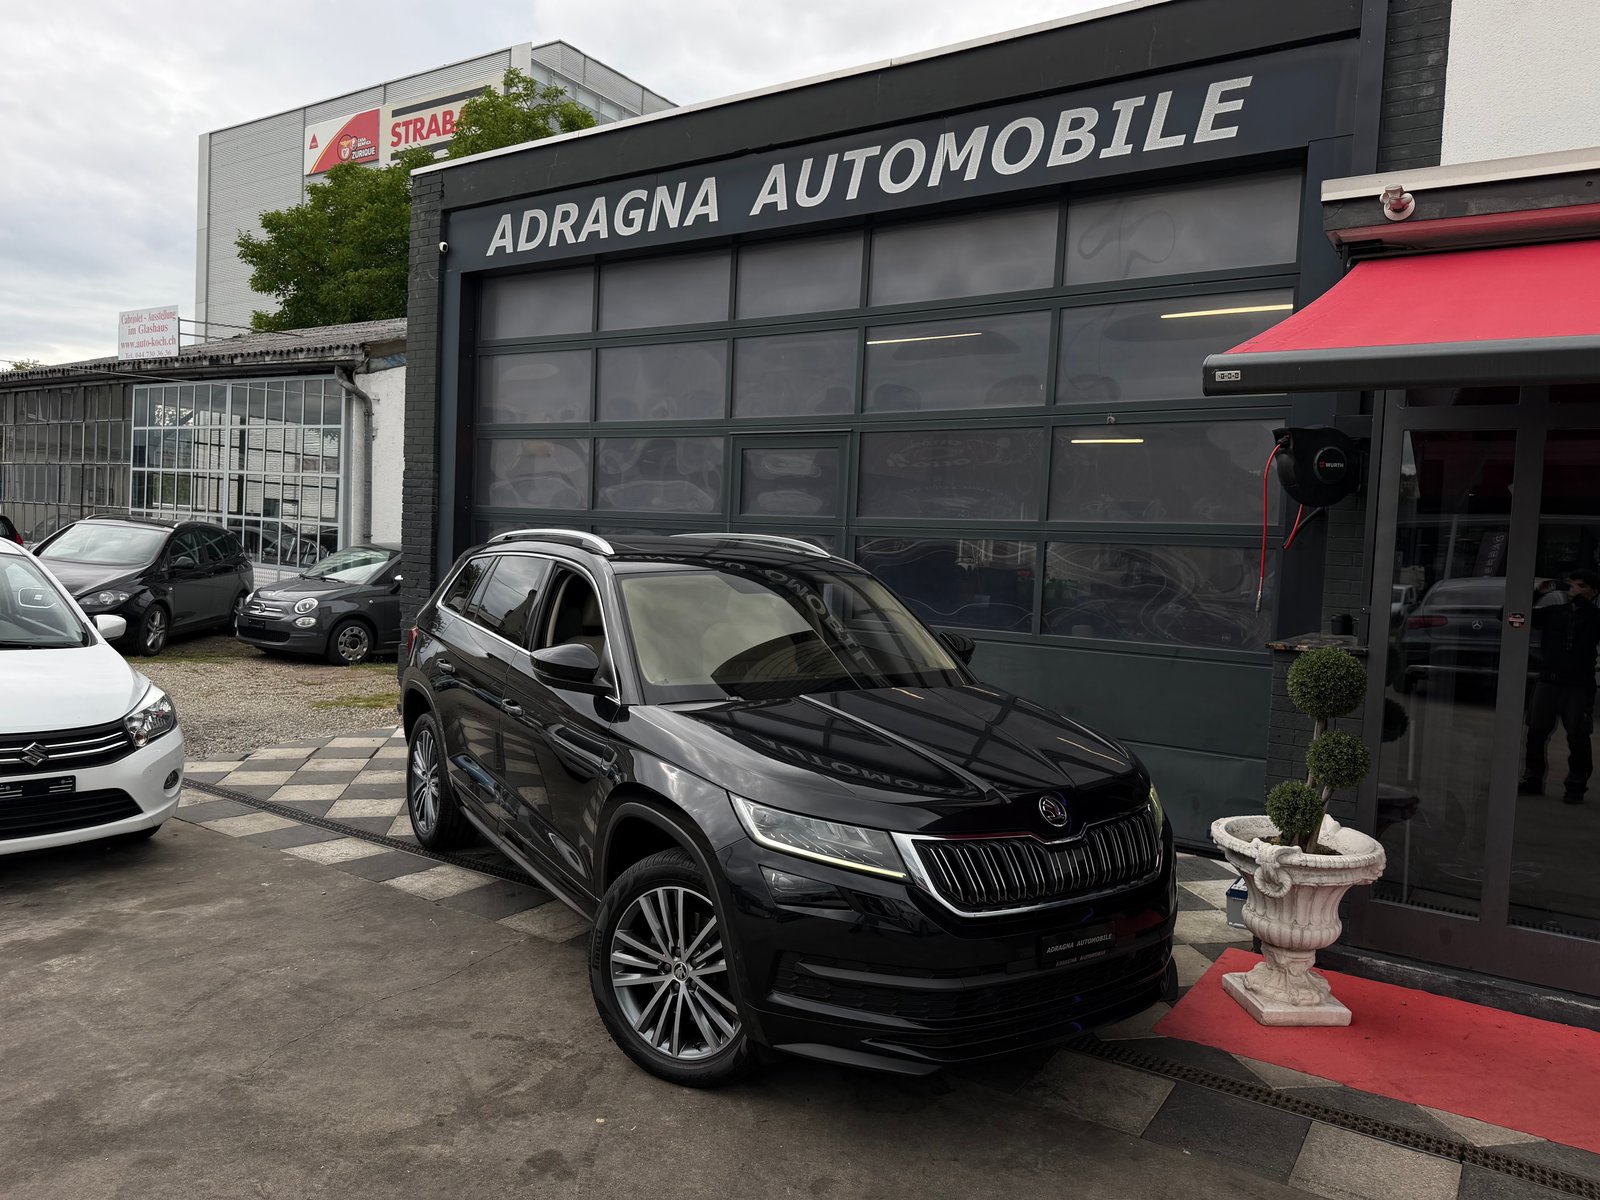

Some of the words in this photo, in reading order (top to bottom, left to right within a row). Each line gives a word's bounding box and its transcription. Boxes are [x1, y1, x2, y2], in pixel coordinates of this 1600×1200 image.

[351, 146, 376, 160] ZURIQUE
[485, 176, 720, 257] ADRAGNA
[749, 75, 1254, 216] AUTOMOBILE
[127, 326, 136, 335] im
[138, 322, 168, 334] Glashaus
[120, 335, 176, 349] www.auto-koch.ch
[1046, 942, 1075, 954] ADRAGNA
[1076, 933, 1112, 947] AUTOMOBILE
